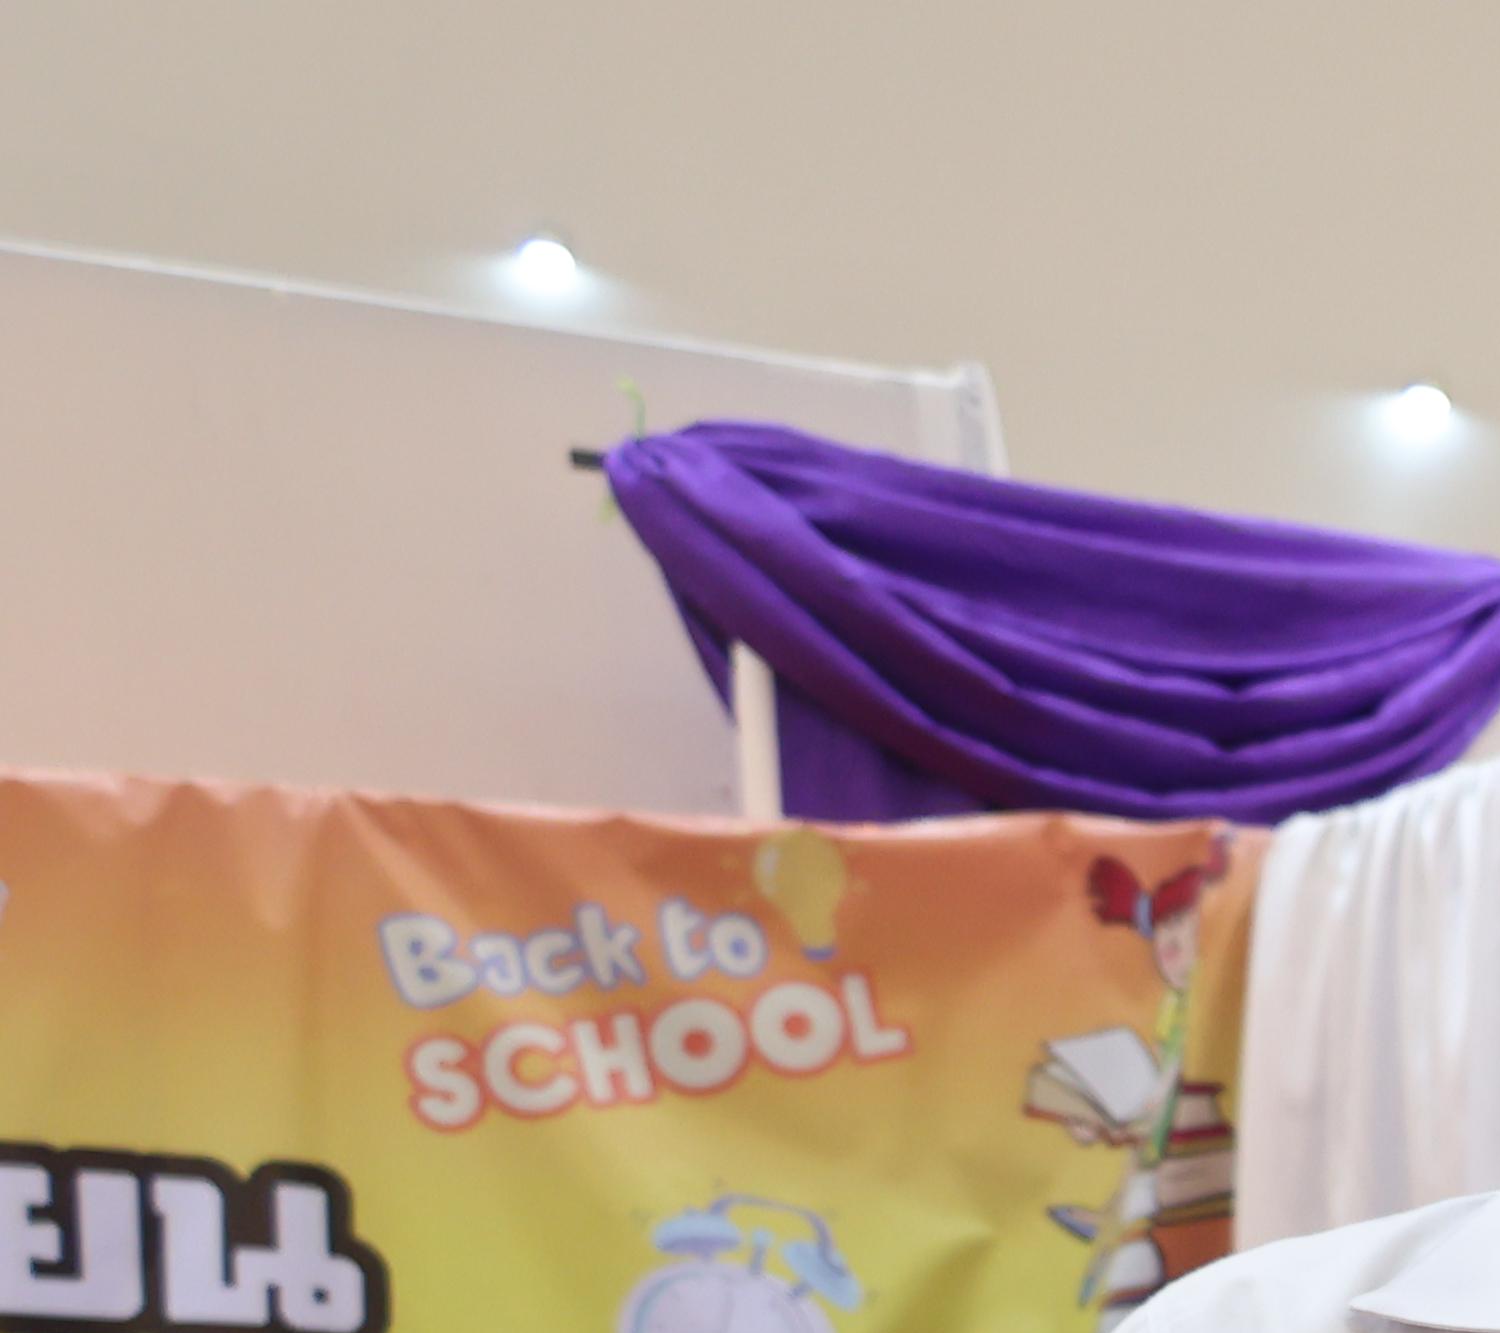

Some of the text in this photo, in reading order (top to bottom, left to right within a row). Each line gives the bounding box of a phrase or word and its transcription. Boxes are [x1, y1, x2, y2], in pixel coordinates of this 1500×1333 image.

[378, 895, 768, 1010] Back to
[406, 967, 914, 1134] SCHOOL
